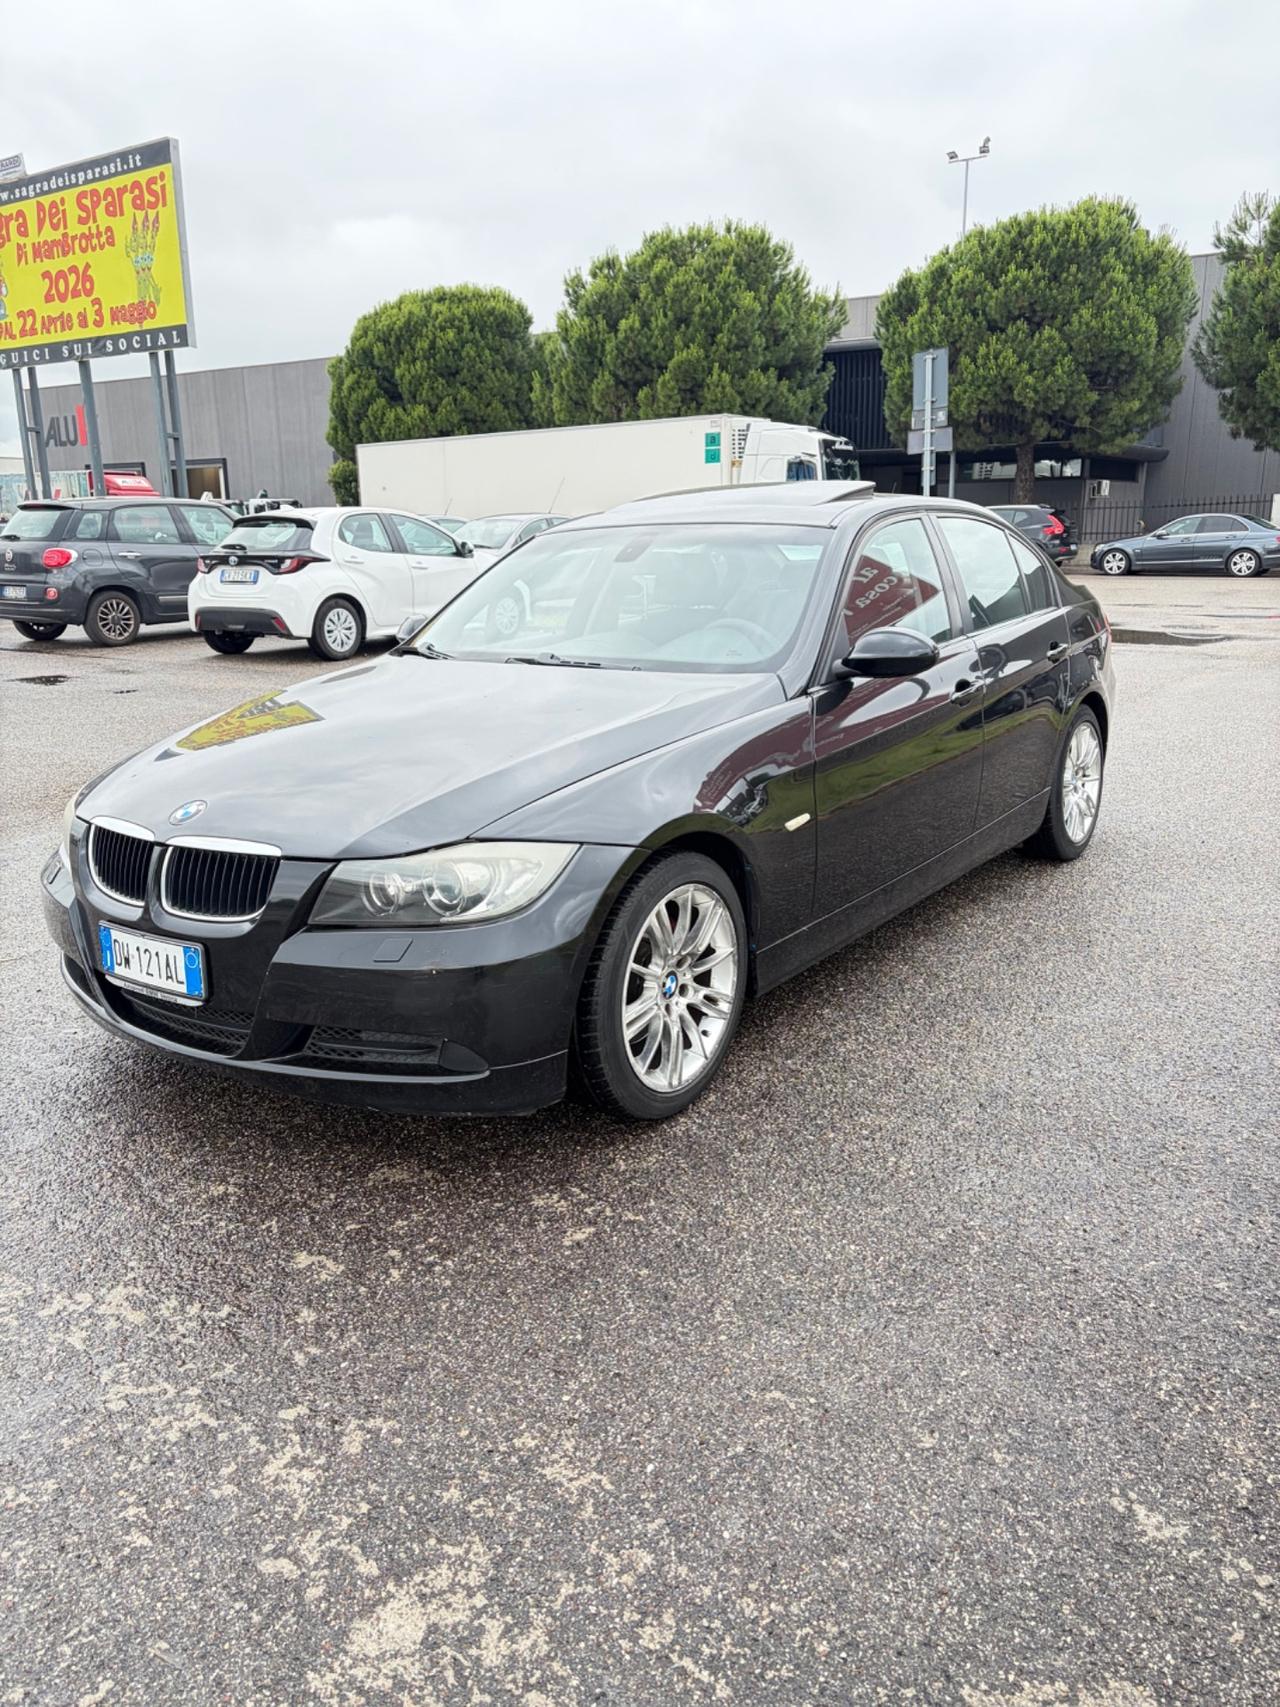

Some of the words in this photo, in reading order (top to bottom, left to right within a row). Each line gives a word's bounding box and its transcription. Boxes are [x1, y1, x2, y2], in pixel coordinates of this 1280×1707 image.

[41, 262, 94, 304] 2026
[17, 308, 38, 338] 22
[91, 297, 104, 328] 3
[62, 342, 92, 358] SUI
[106, 331, 180, 352] SOCIAL
